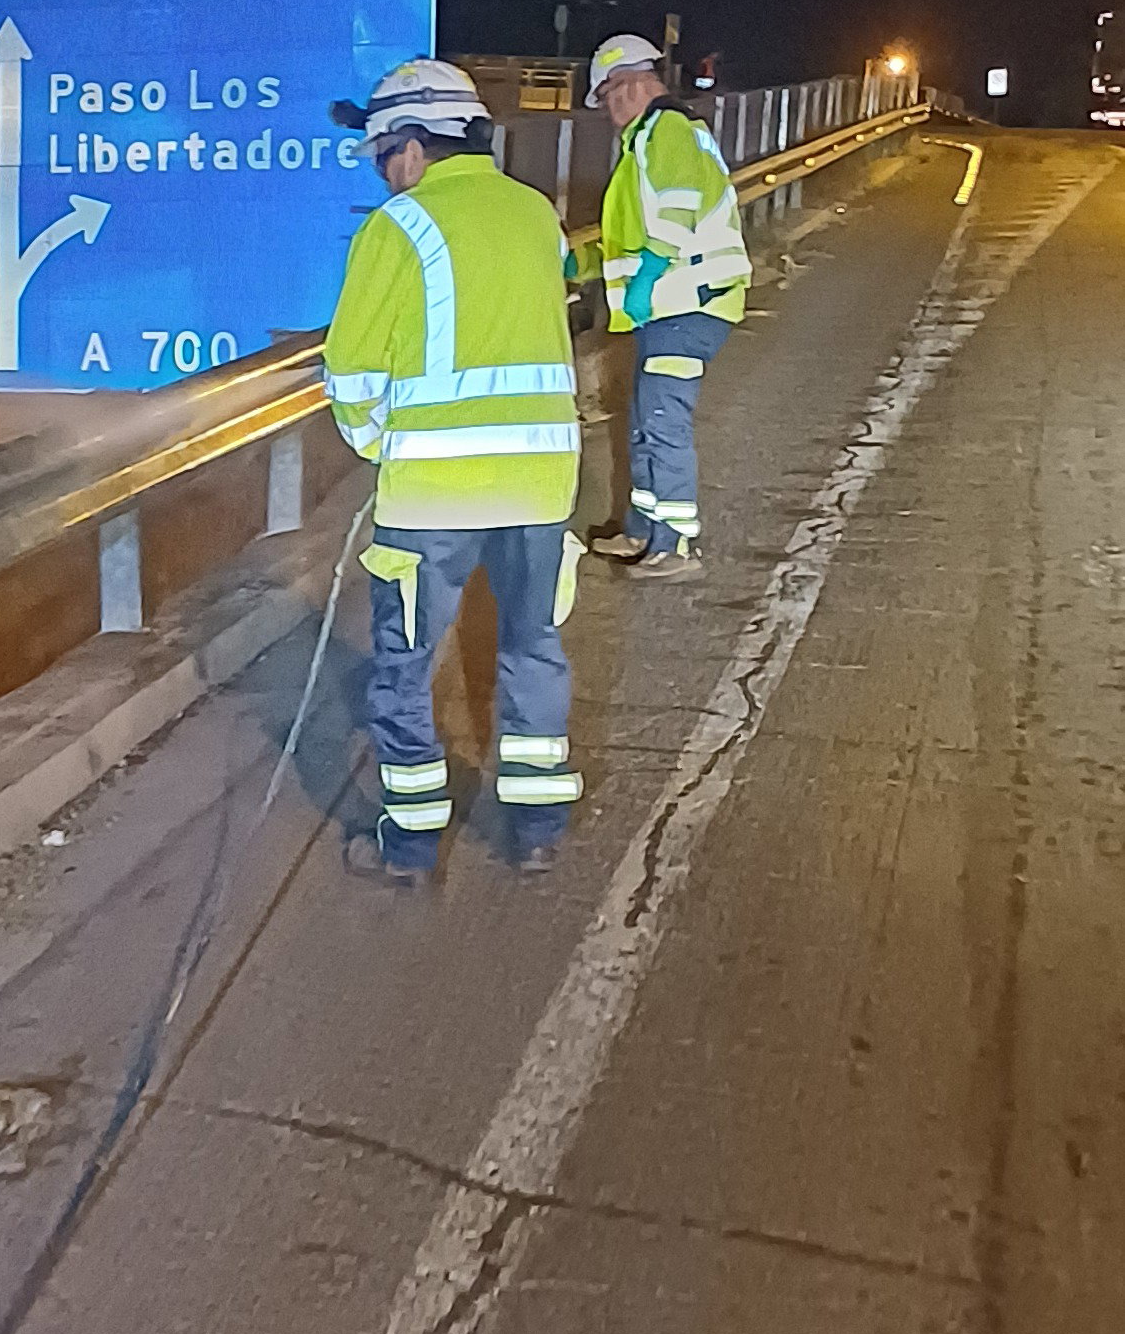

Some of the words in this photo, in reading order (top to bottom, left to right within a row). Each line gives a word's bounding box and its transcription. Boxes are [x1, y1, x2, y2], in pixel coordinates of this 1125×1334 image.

[49, 73, 167, 114] Paso
[189, 69, 281, 111] Los
[49, 128, 361, 174] Libertadore
[80, 332, 111, 371] A
[141, 330, 238, 373] 700
